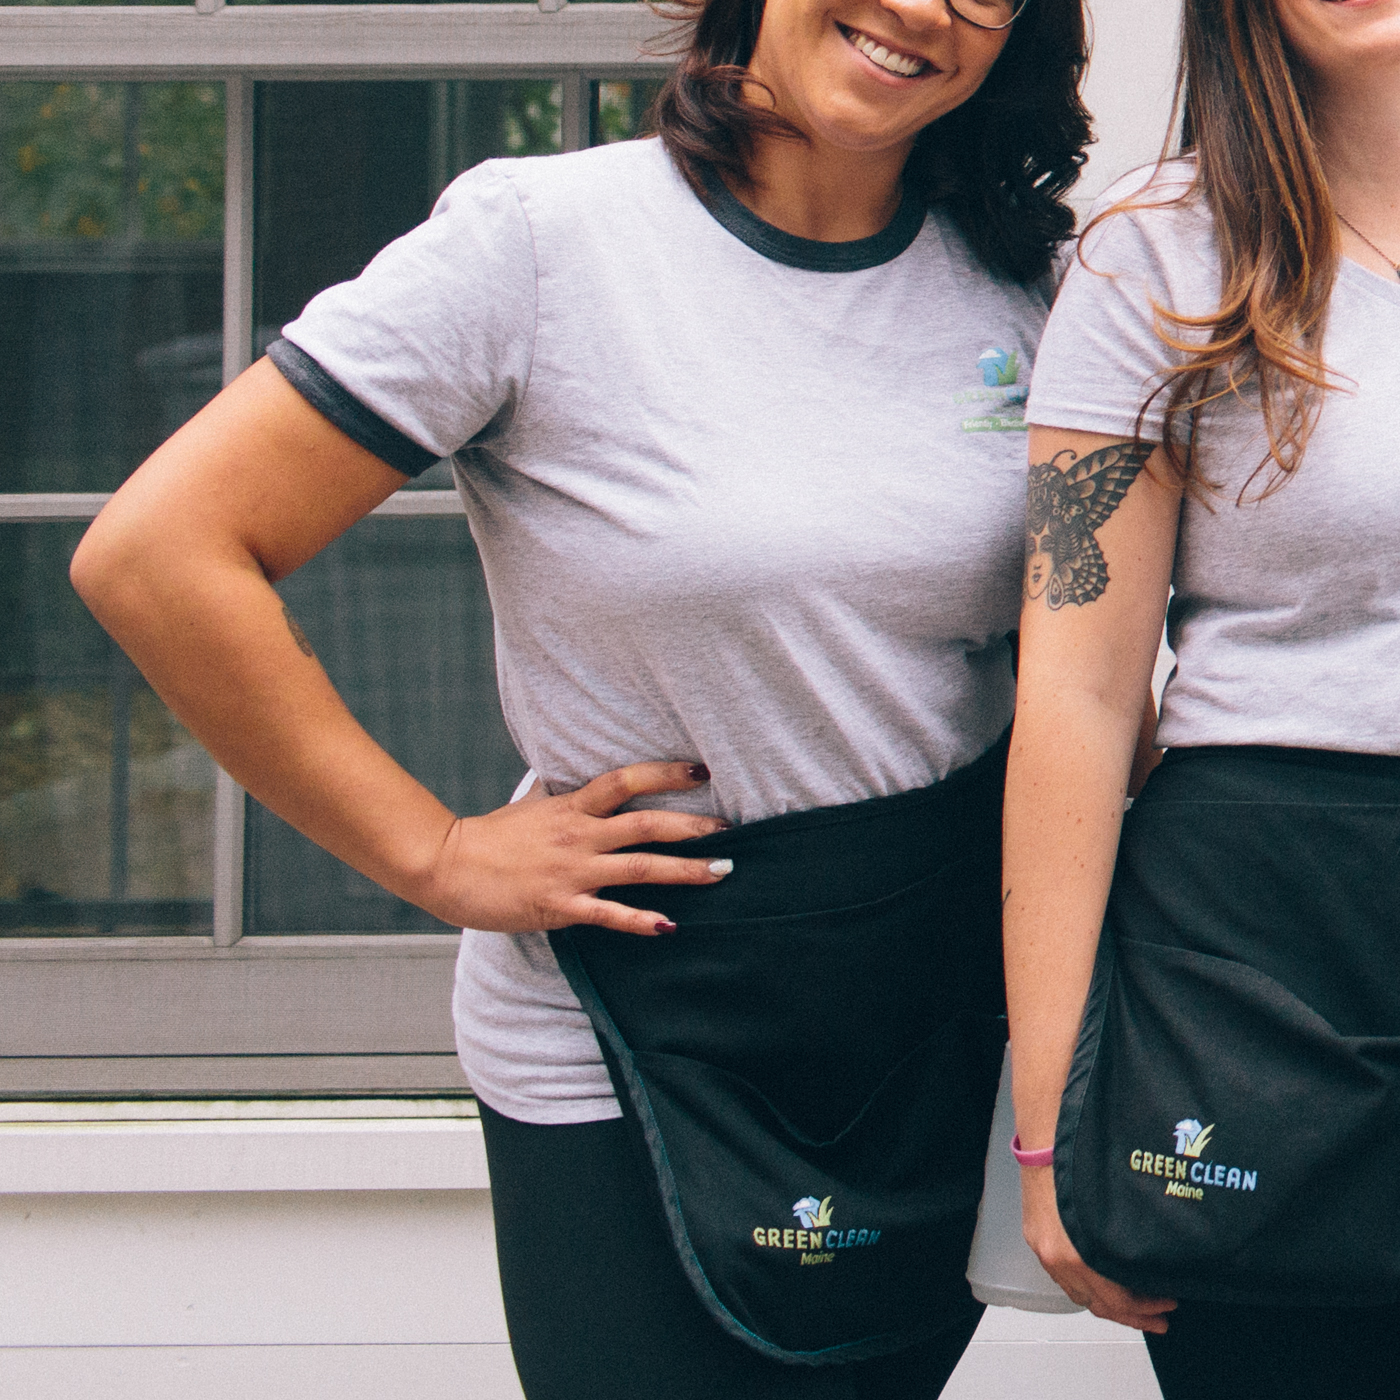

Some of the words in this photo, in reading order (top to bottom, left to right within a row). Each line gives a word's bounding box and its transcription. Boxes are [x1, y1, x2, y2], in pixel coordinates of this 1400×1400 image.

[1130, 1149, 1188, 1180] GREEN
[1190, 1160, 1258, 1192] CLEAN
[1165, 1180, 1204, 1201] Maine
[753, 1226, 823, 1250] GREEN
[825, 1228, 881, 1249] CLEAN
[800, 1251, 836, 1266] Maine
